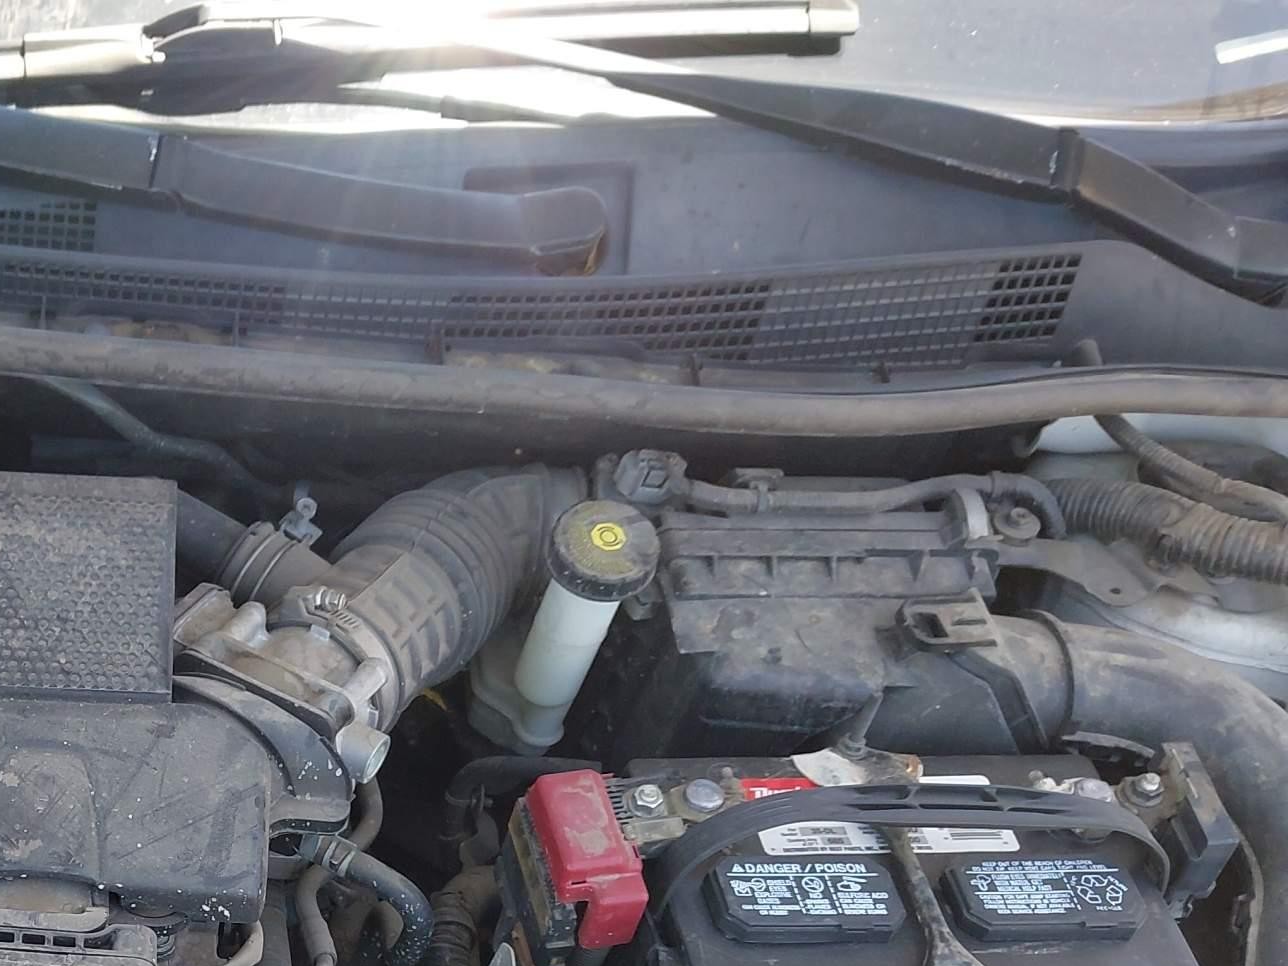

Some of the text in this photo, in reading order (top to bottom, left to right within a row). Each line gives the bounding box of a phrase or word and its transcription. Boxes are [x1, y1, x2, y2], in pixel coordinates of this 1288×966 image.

[743, 863, 866, 873] DANGER / POISON
